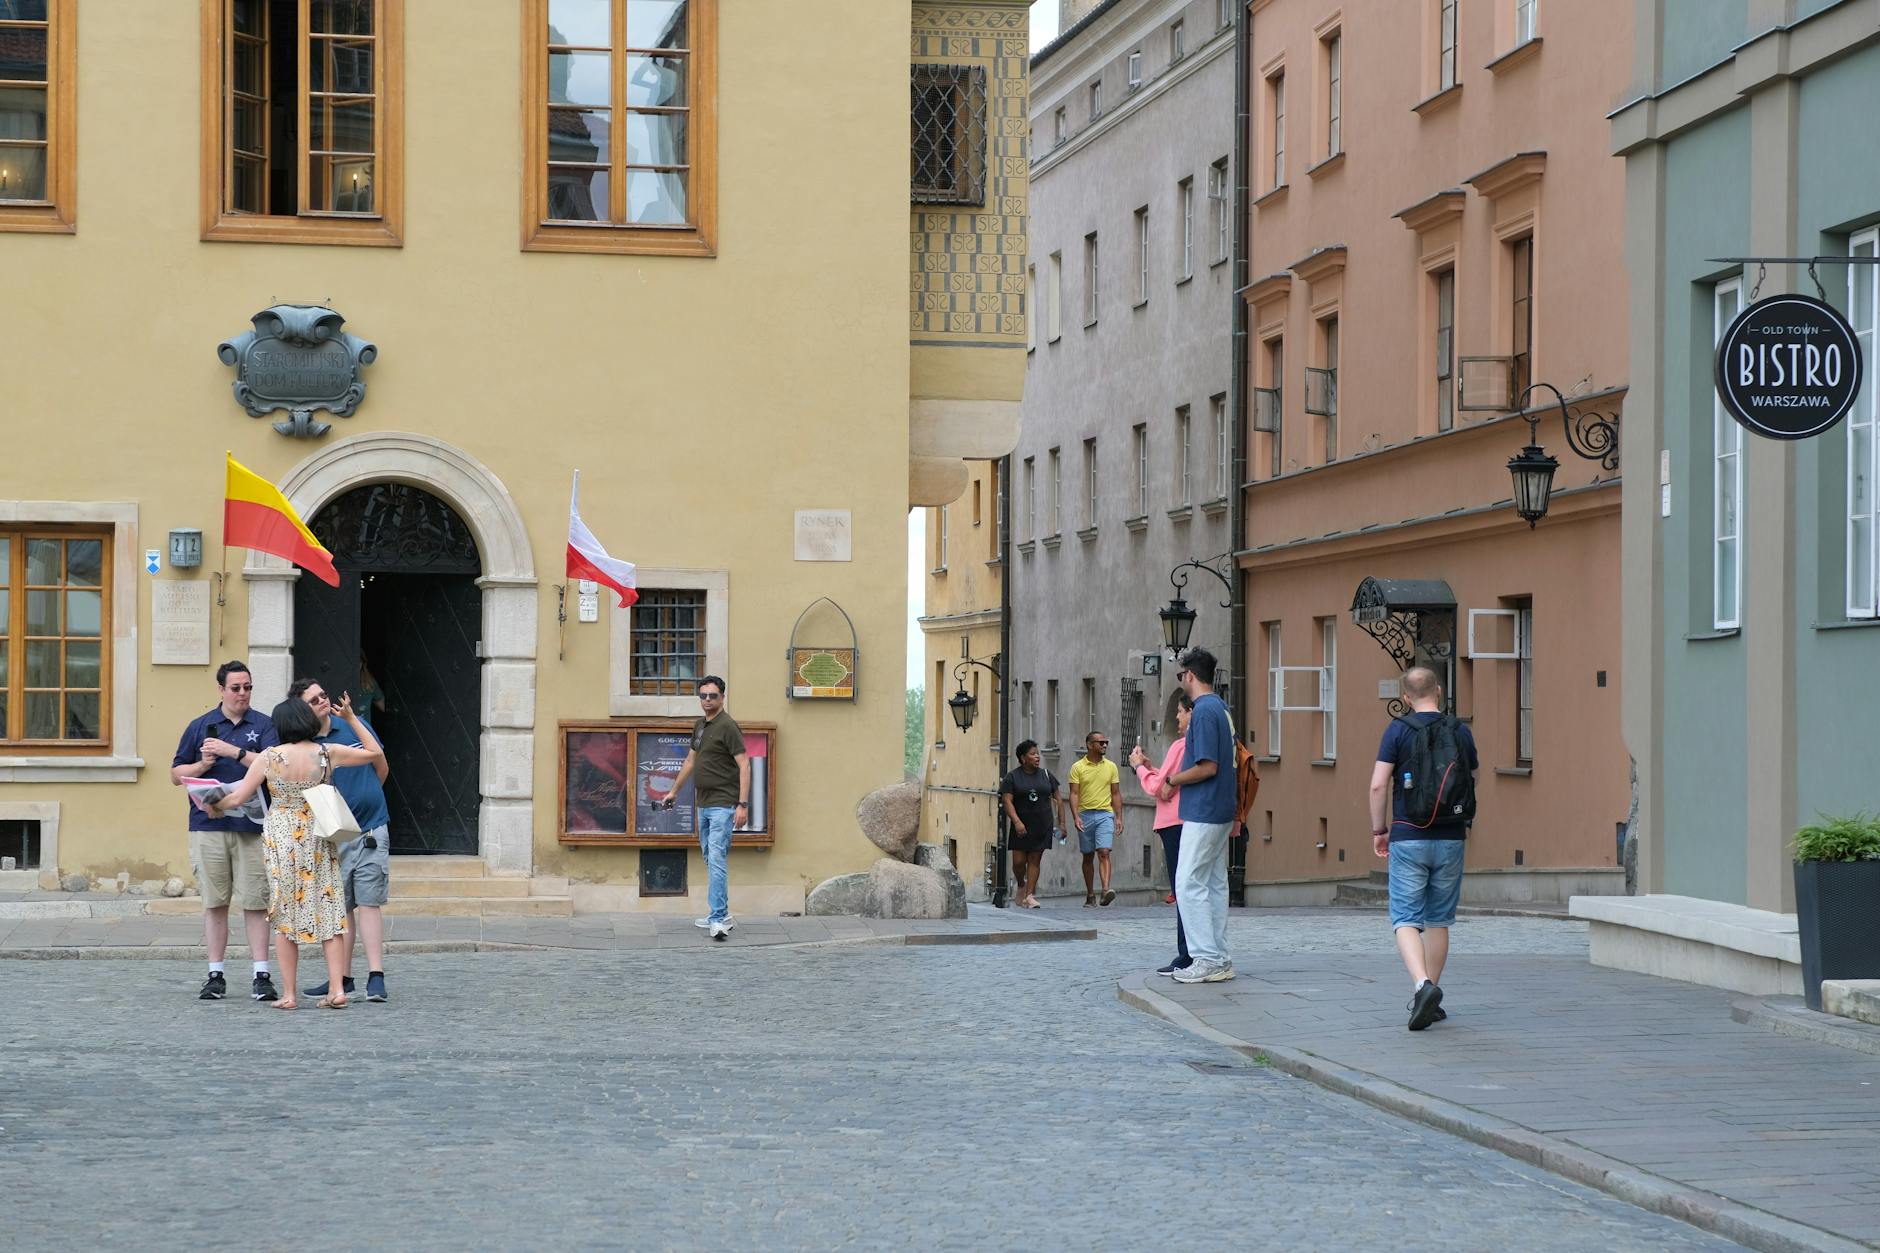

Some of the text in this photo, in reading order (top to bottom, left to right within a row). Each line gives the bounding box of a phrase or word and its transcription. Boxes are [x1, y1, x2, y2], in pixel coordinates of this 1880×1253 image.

[1762, 326, 1819, 335] OLD TOWN
[253, 351, 345, 368] STAROMIEJSKI
[1739, 343, 1841, 387] BISTRO
[255, 372, 347, 387] DOM KULTURY
[1751, 395, 1831, 407] WARSZAWA
[801, 515, 845, 528] RYNEK
